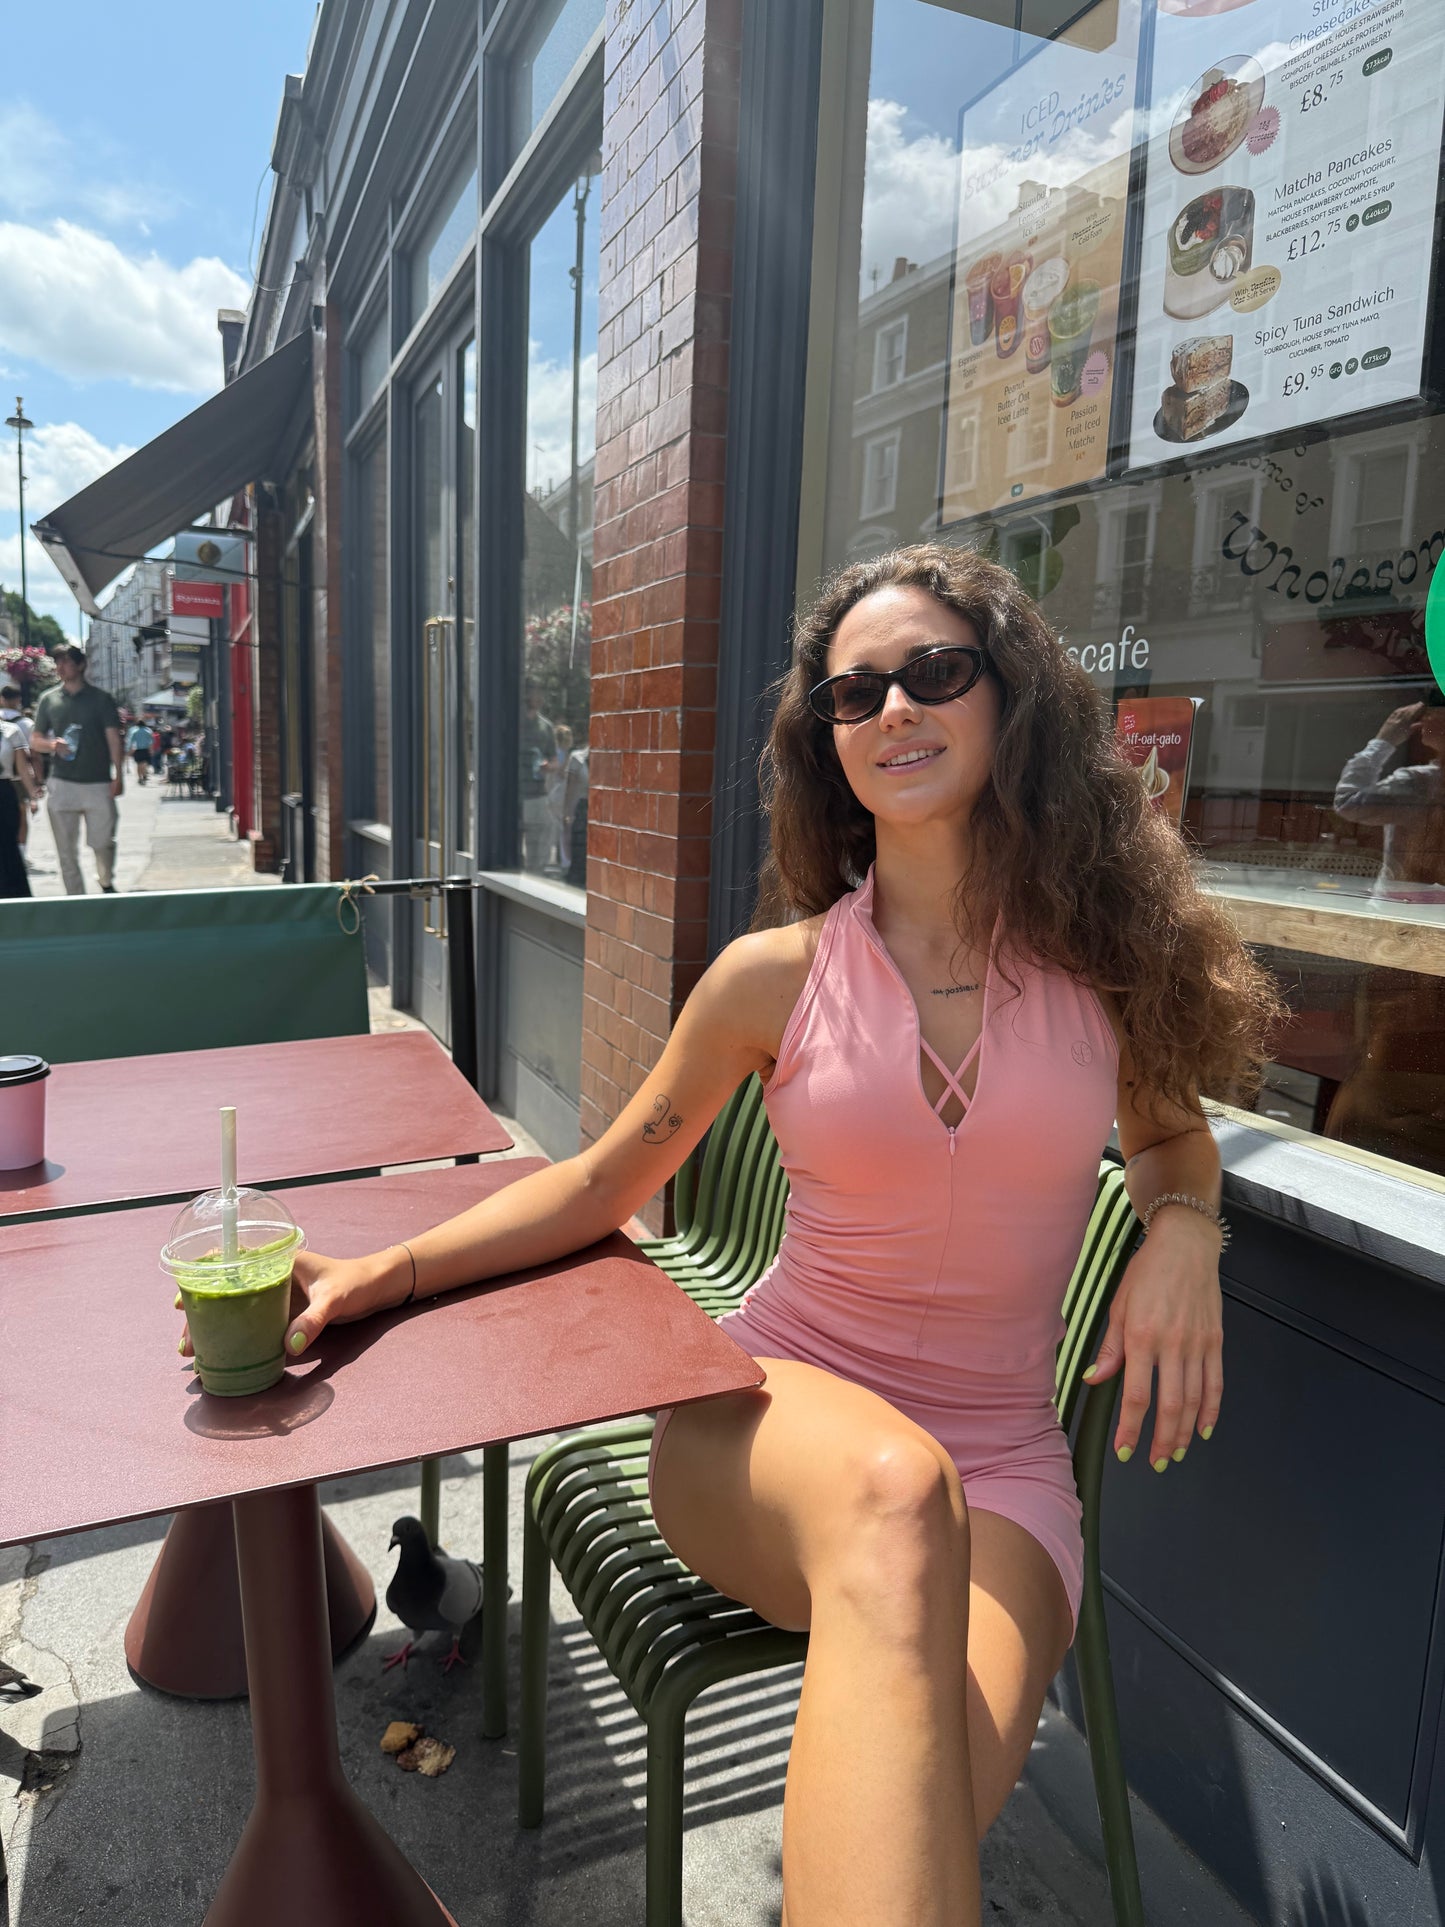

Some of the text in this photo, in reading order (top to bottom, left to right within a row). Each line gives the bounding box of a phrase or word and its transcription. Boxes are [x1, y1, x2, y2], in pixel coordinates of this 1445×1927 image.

[1289, 0, 1370, 51] Cheesecake
[1335, 21, 1358, 40] HOUSE
[1313, 37, 1355, 65] CHEESECAKE
[1355, 22, 1384, 42] PROTEIN
[1289, 70, 1316, 90] BISCOFF
[1348, 29, 1393, 58] STRAWBERRY
[1021, 90, 1060, 134] ICED
[1048, 72, 1127, 145] Drinks
[1274, 138, 1392, 201] Matcha Pancakes
[1268, 203, 1293, 218] MATCHA
[1328, 170, 1361, 192] COCONUT
[1281, 211, 1302, 224] HOUSE
[1303, 191, 1344, 216] STRAWBERRY
[1310, 210, 1328, 225] SOFT
[1350, 191, 1373, 207] MAPLE
[1373, 181, 1396, 198] SYRUP
[1254, 286, 1394, 347] Spicy Tuna Sandwich
[1302, 330, 1323, 344] HOUSE
[1323, 324, 1341, 337] SPICY
[1341, 319, 1360, 331] TUNA
[1324, 334, 1350, 348] TOMATO
[997, 391, 1032, 413] Butter Oat
[1004, 379, 1026, 397] Peanut
[997, 406, 1030, 427] Iced Latte
[1065, 415, 1101, 438] Fruit Iced
[1070, 403, 1098, 421] Passion
[1069, 434, 1096, 450] Matcha
[1125, 732, 1182, 748] Aff-oat-gato
